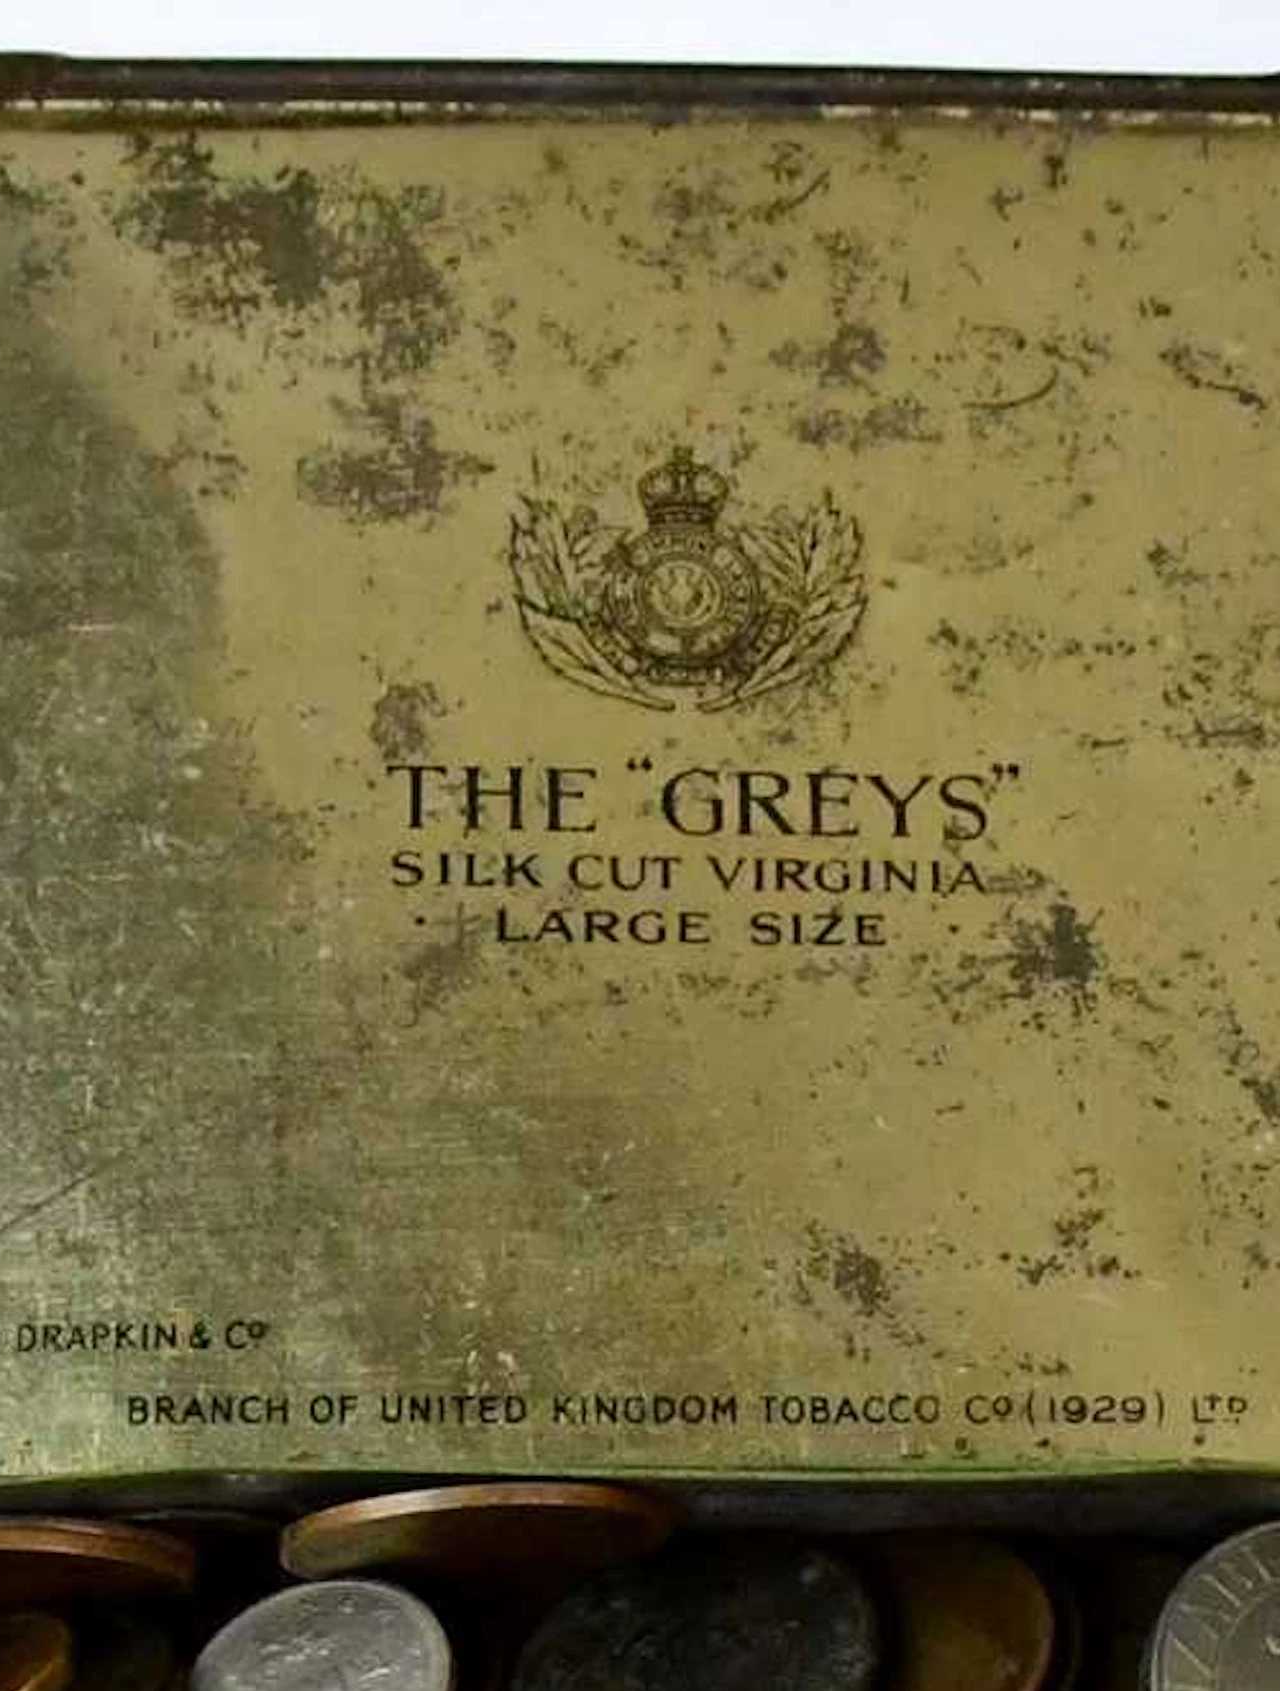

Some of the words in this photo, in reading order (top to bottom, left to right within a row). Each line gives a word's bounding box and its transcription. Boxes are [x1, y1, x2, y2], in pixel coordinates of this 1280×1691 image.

[387, 764, 598, 834] THE
[390, 850, 543, 890] SILK
[567, 853, 683, 893] CUT
[706, 855, 988, 894] VIRGINIA
[495, 908, 712, 945] LARGE
[750, 911, 887, 947] SIZE
[17, 1321, 178, 1354] DRAPKIN
[188, 1322, 211, 1351] &
[128, 1395, 290, 1426] BRANCH
[309, 1395, 360, 1425] OF
[380, 1394, 528, 1426] UNITED
[553, 1394, 738, 1425] KINGDOM
[763, 1394, 941, 1425] TOBACCO
